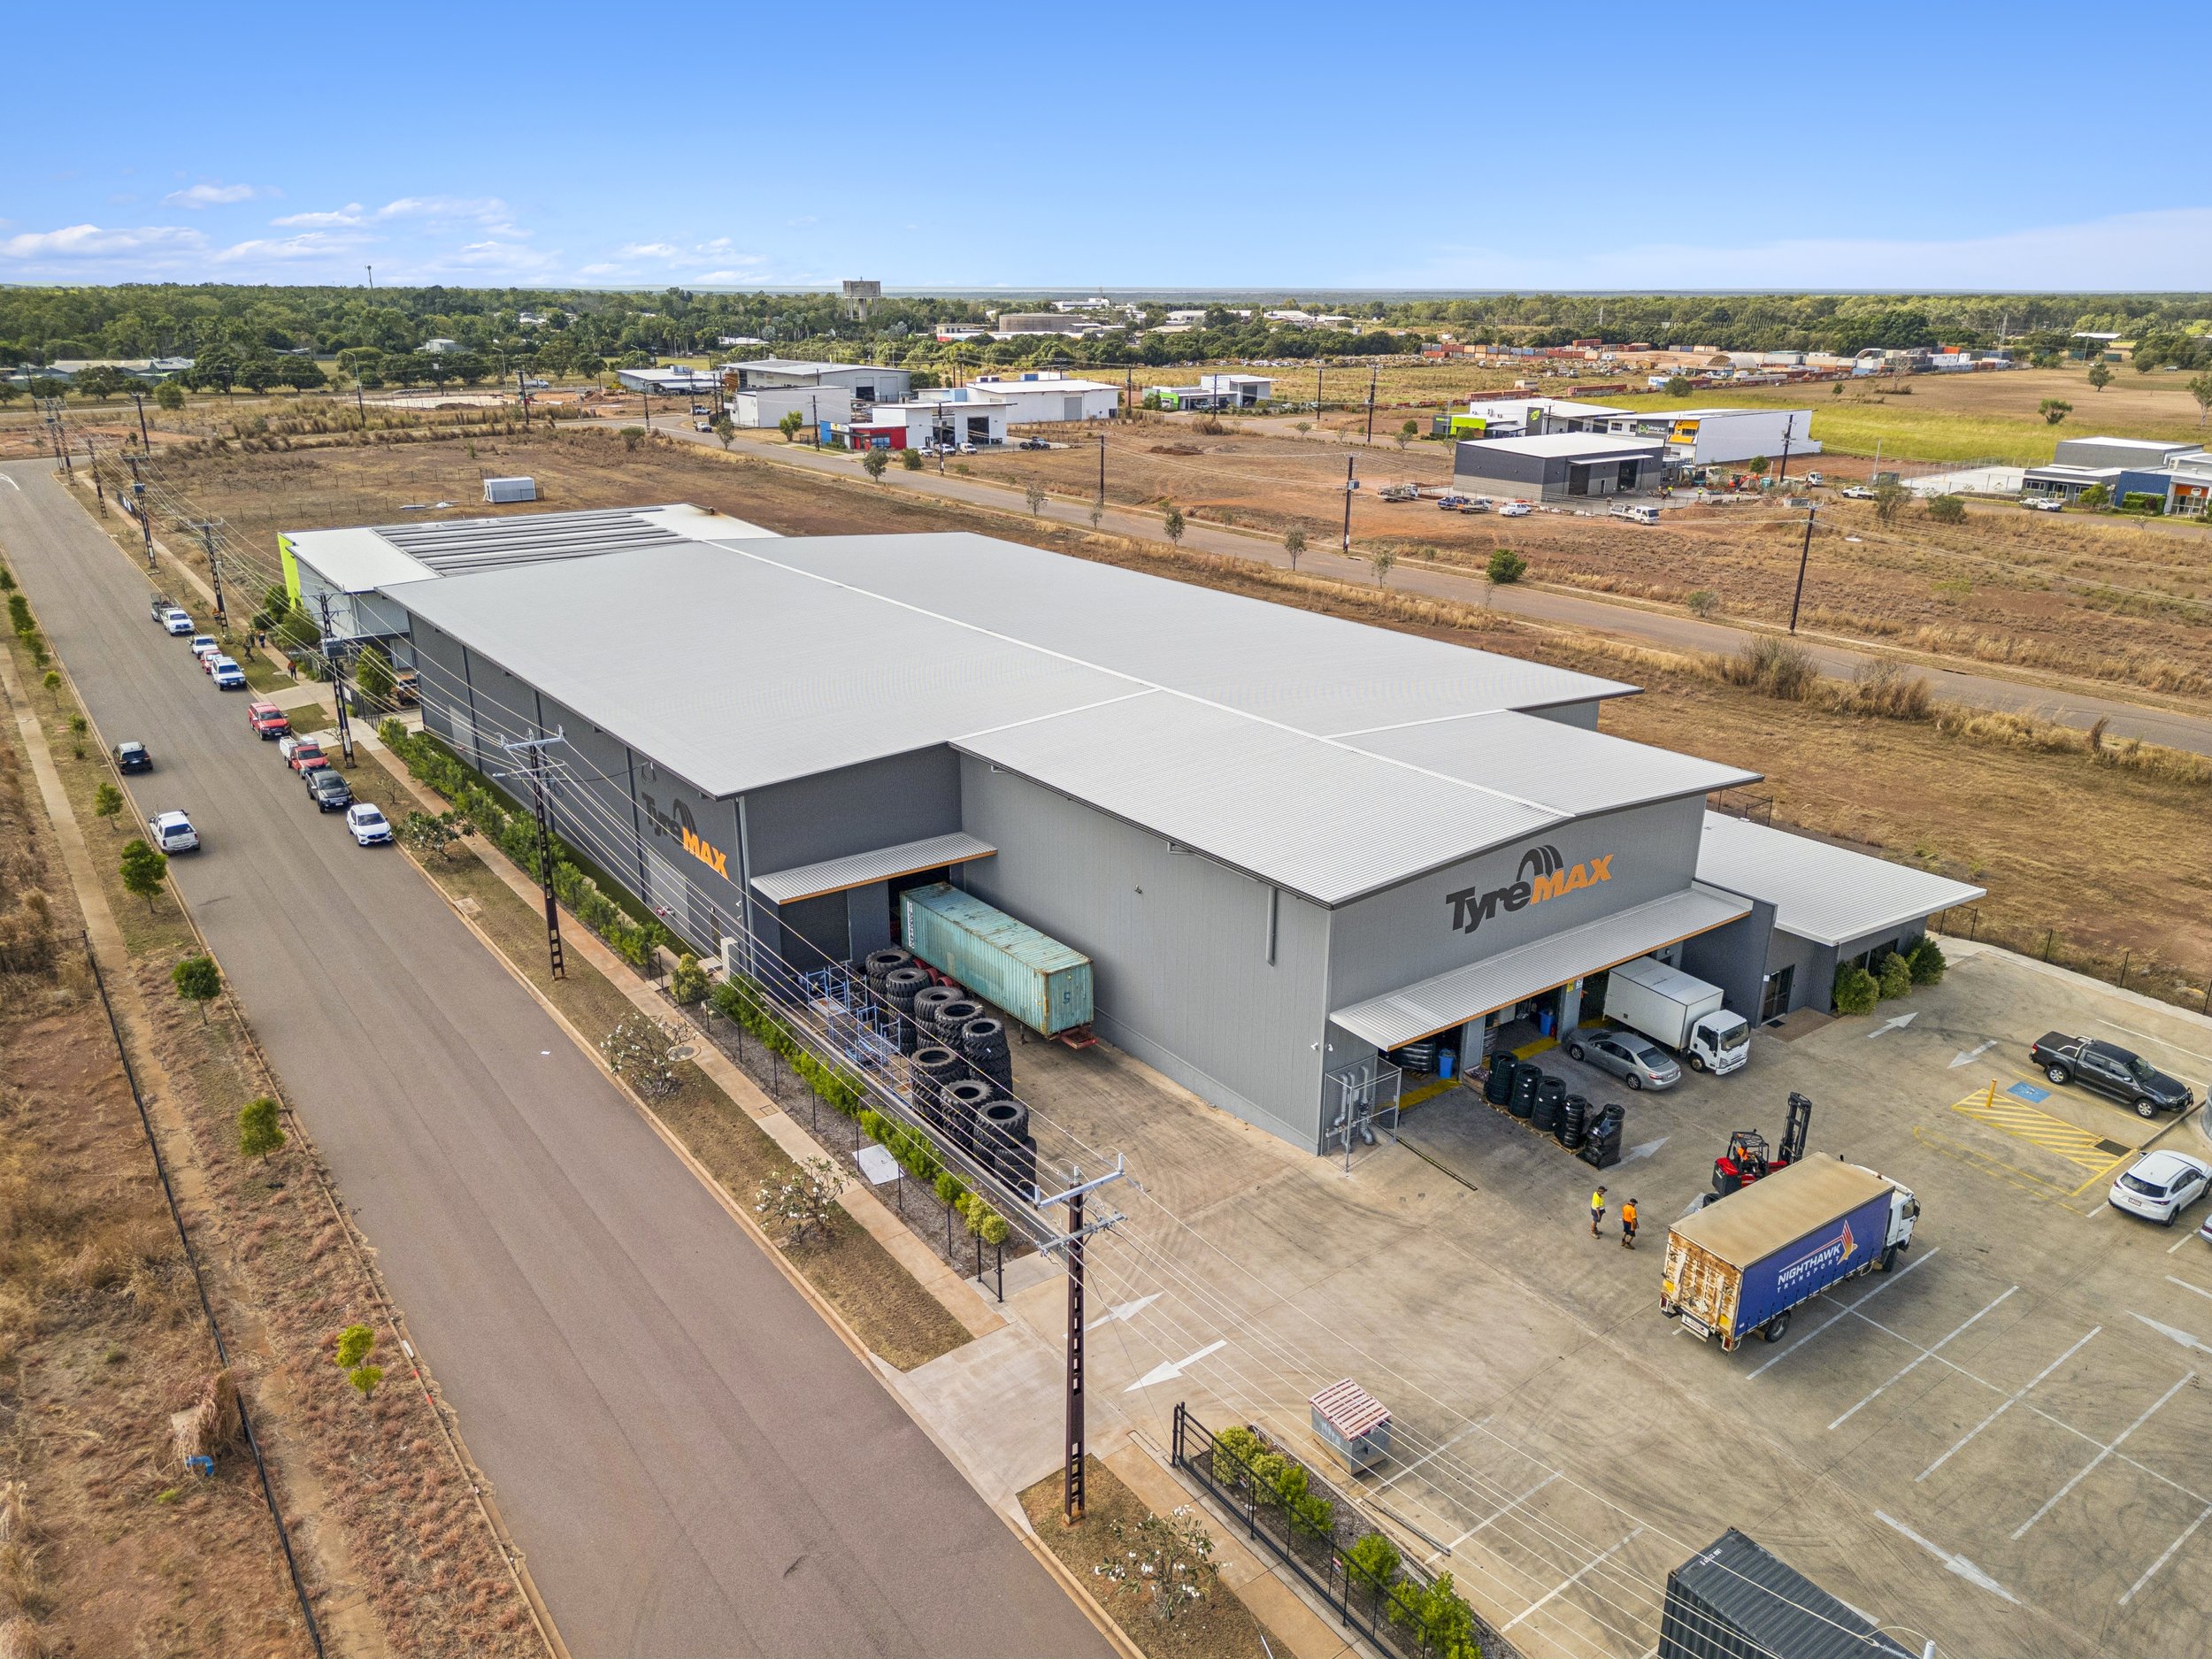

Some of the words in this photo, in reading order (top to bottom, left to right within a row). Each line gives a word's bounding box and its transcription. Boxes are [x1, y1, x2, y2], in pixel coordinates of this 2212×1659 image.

[1446, 854, 1614, 934] TyreMAX
[1777, 1256, 1839, 1294] TRANSPORT
[1778, 1243, 1841, 1286] NIGHTHAWK
